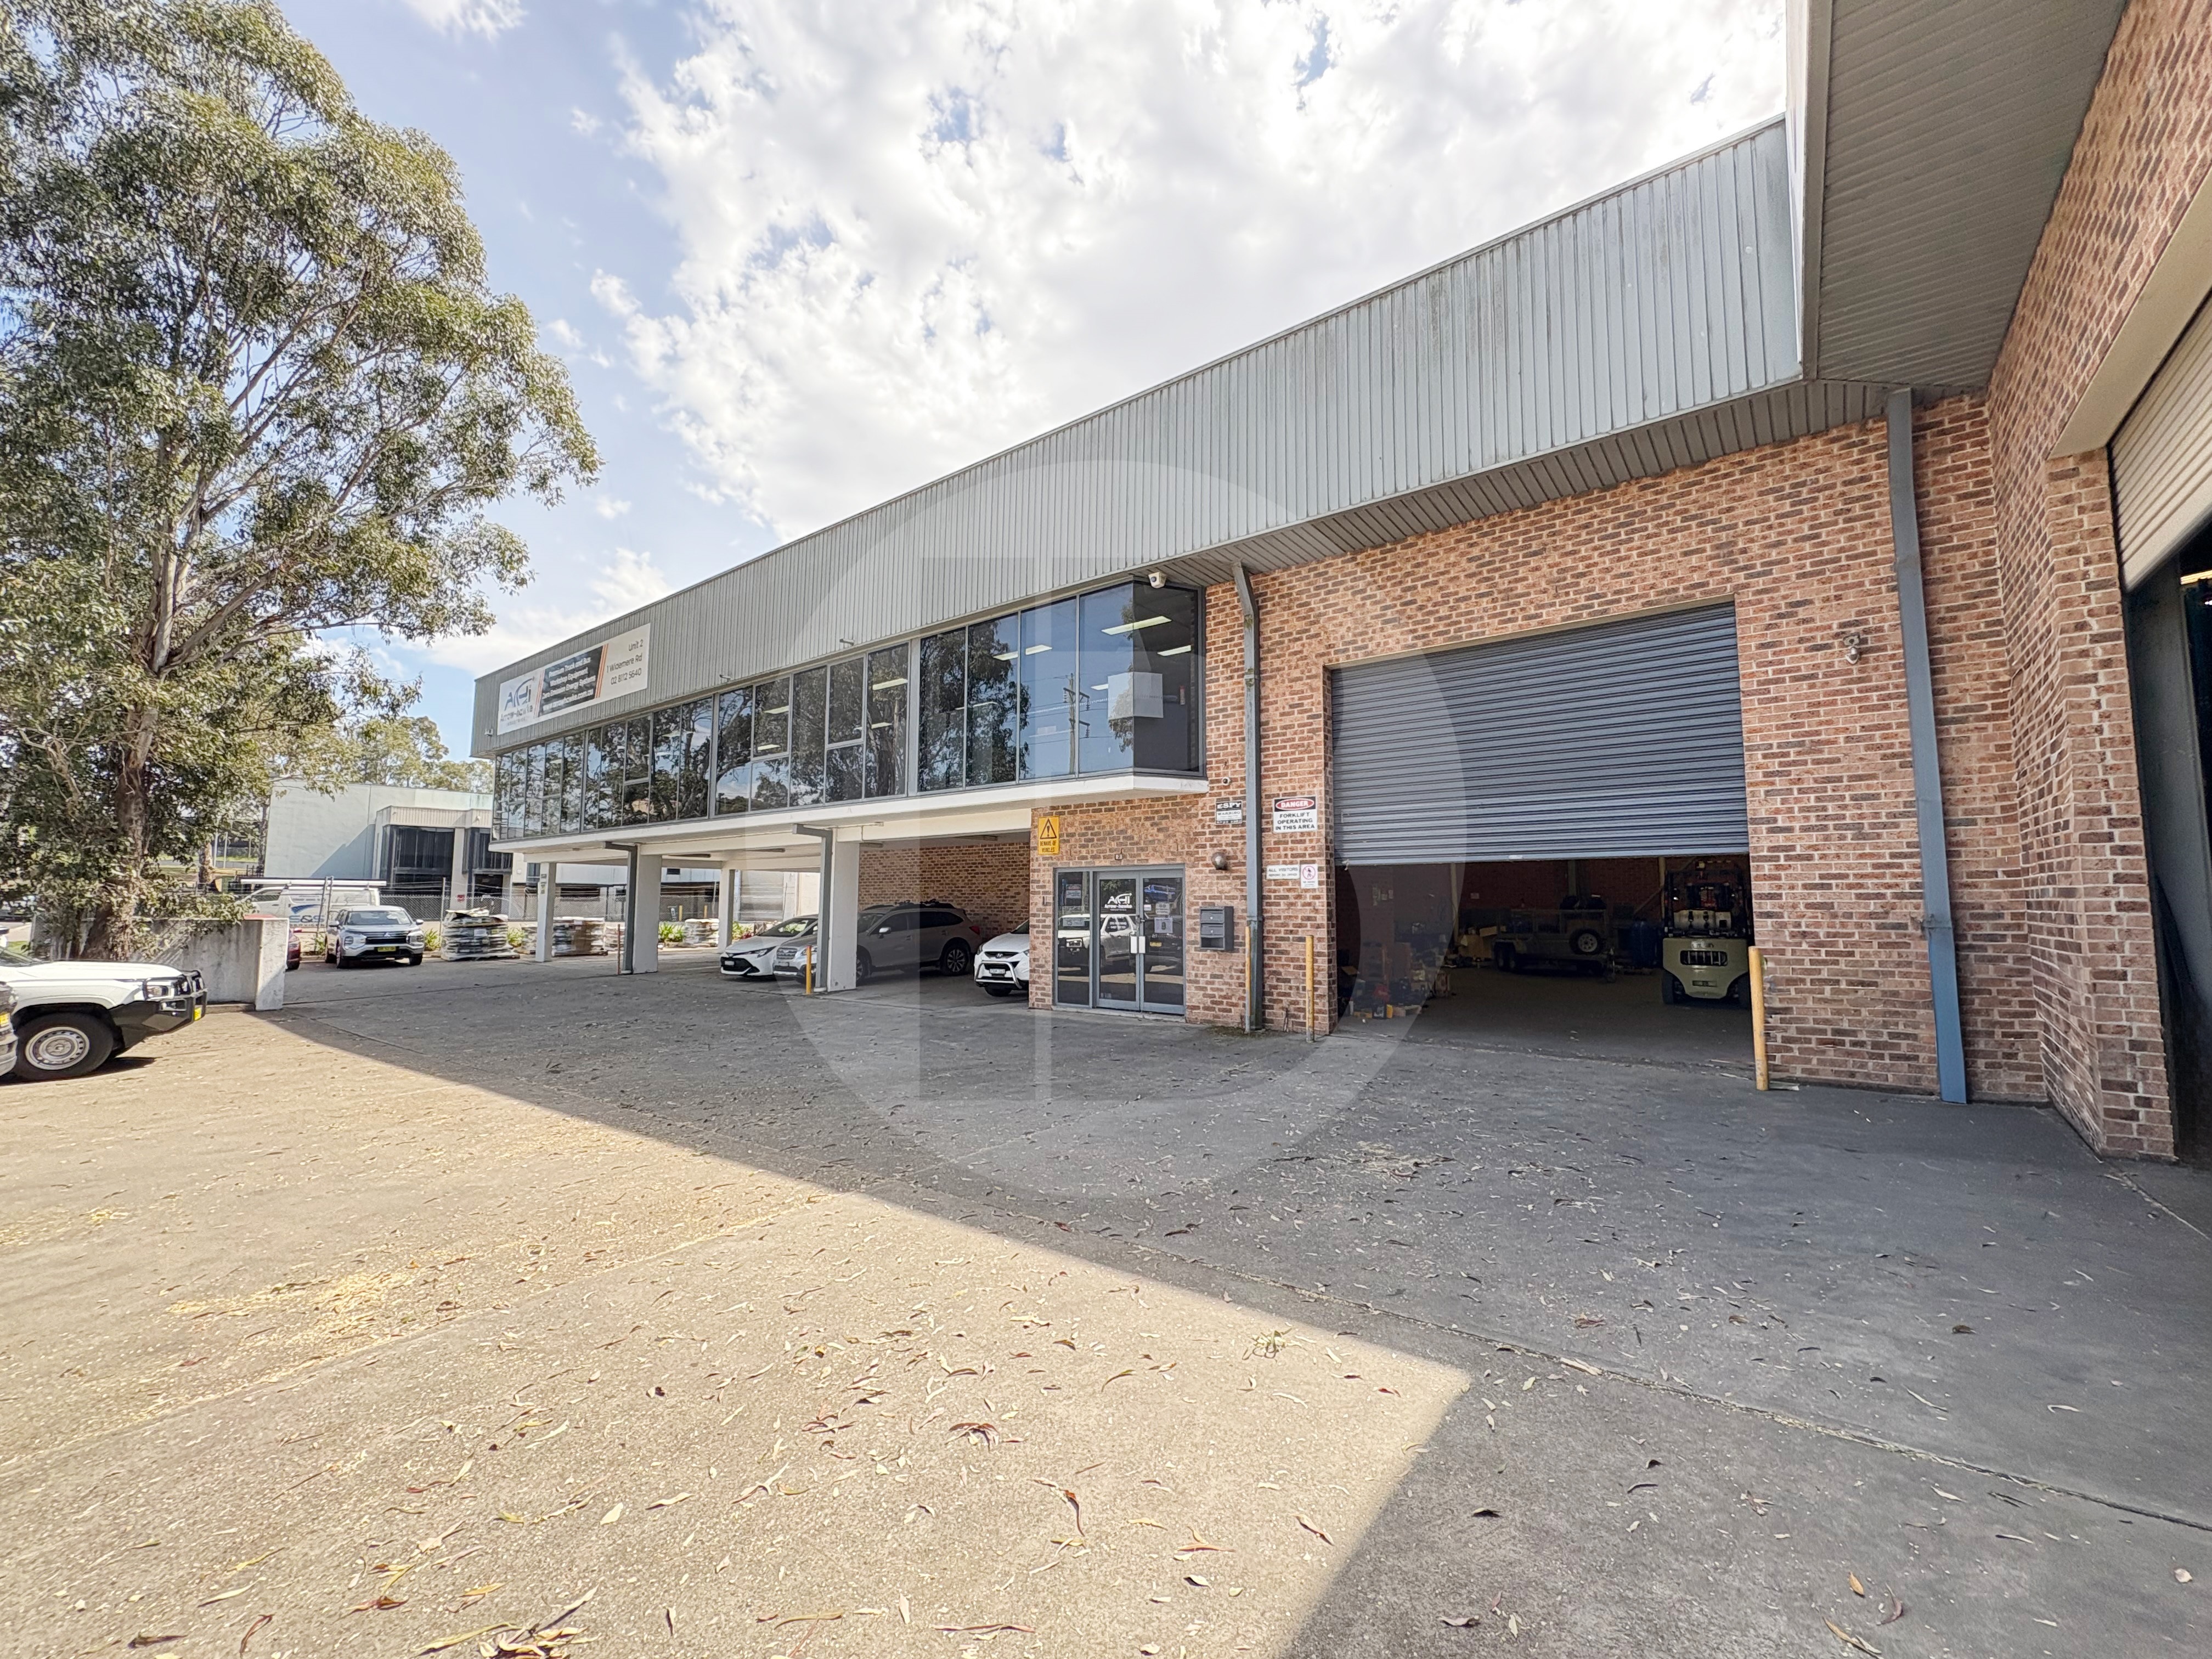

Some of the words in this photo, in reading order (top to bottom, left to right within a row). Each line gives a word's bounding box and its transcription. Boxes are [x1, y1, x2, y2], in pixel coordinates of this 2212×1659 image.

[640, 639, 644, 647] 2
[635, 652, 643, 663] Rd
[629, 668, 642, 679] 5640
